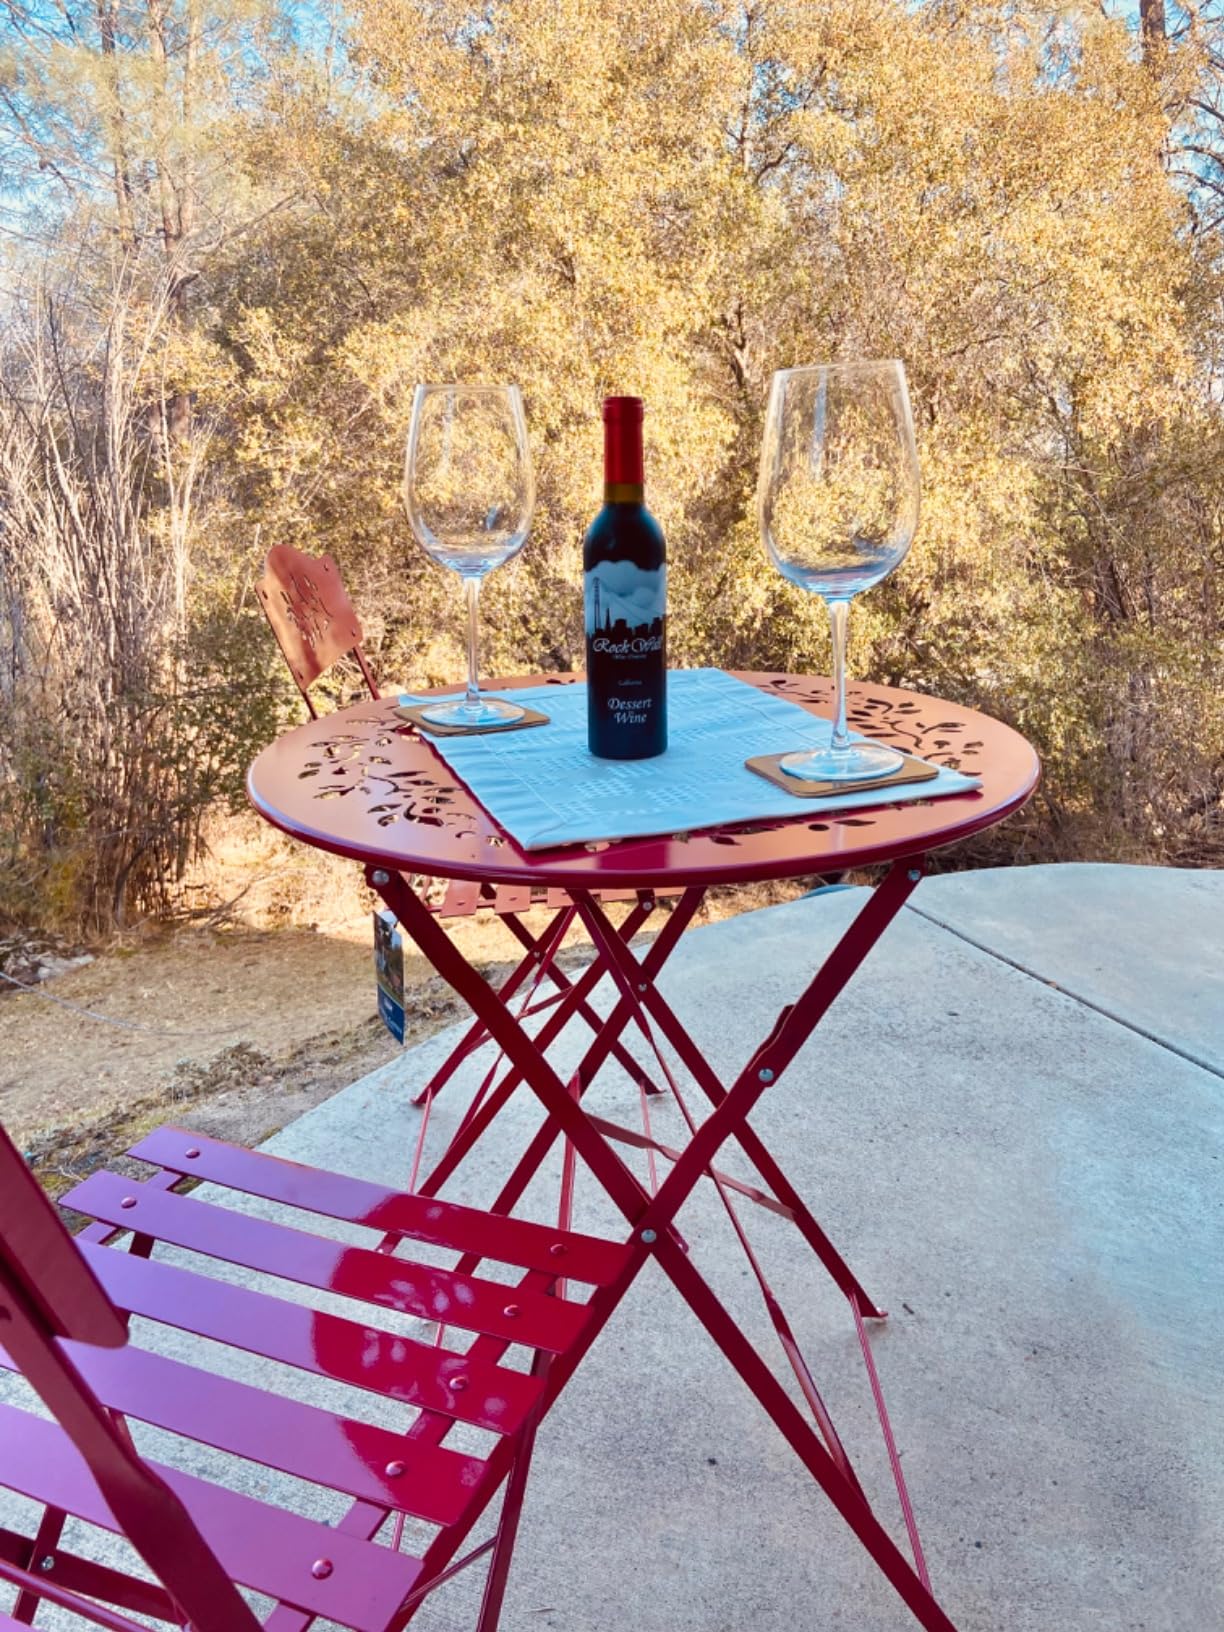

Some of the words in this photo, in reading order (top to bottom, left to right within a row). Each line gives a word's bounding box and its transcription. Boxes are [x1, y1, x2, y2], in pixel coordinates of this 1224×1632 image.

[593, 638, 630, 653] Rock
[608, 697, 652, 710] Dessert
[614, 711, 647, 724] Wine
